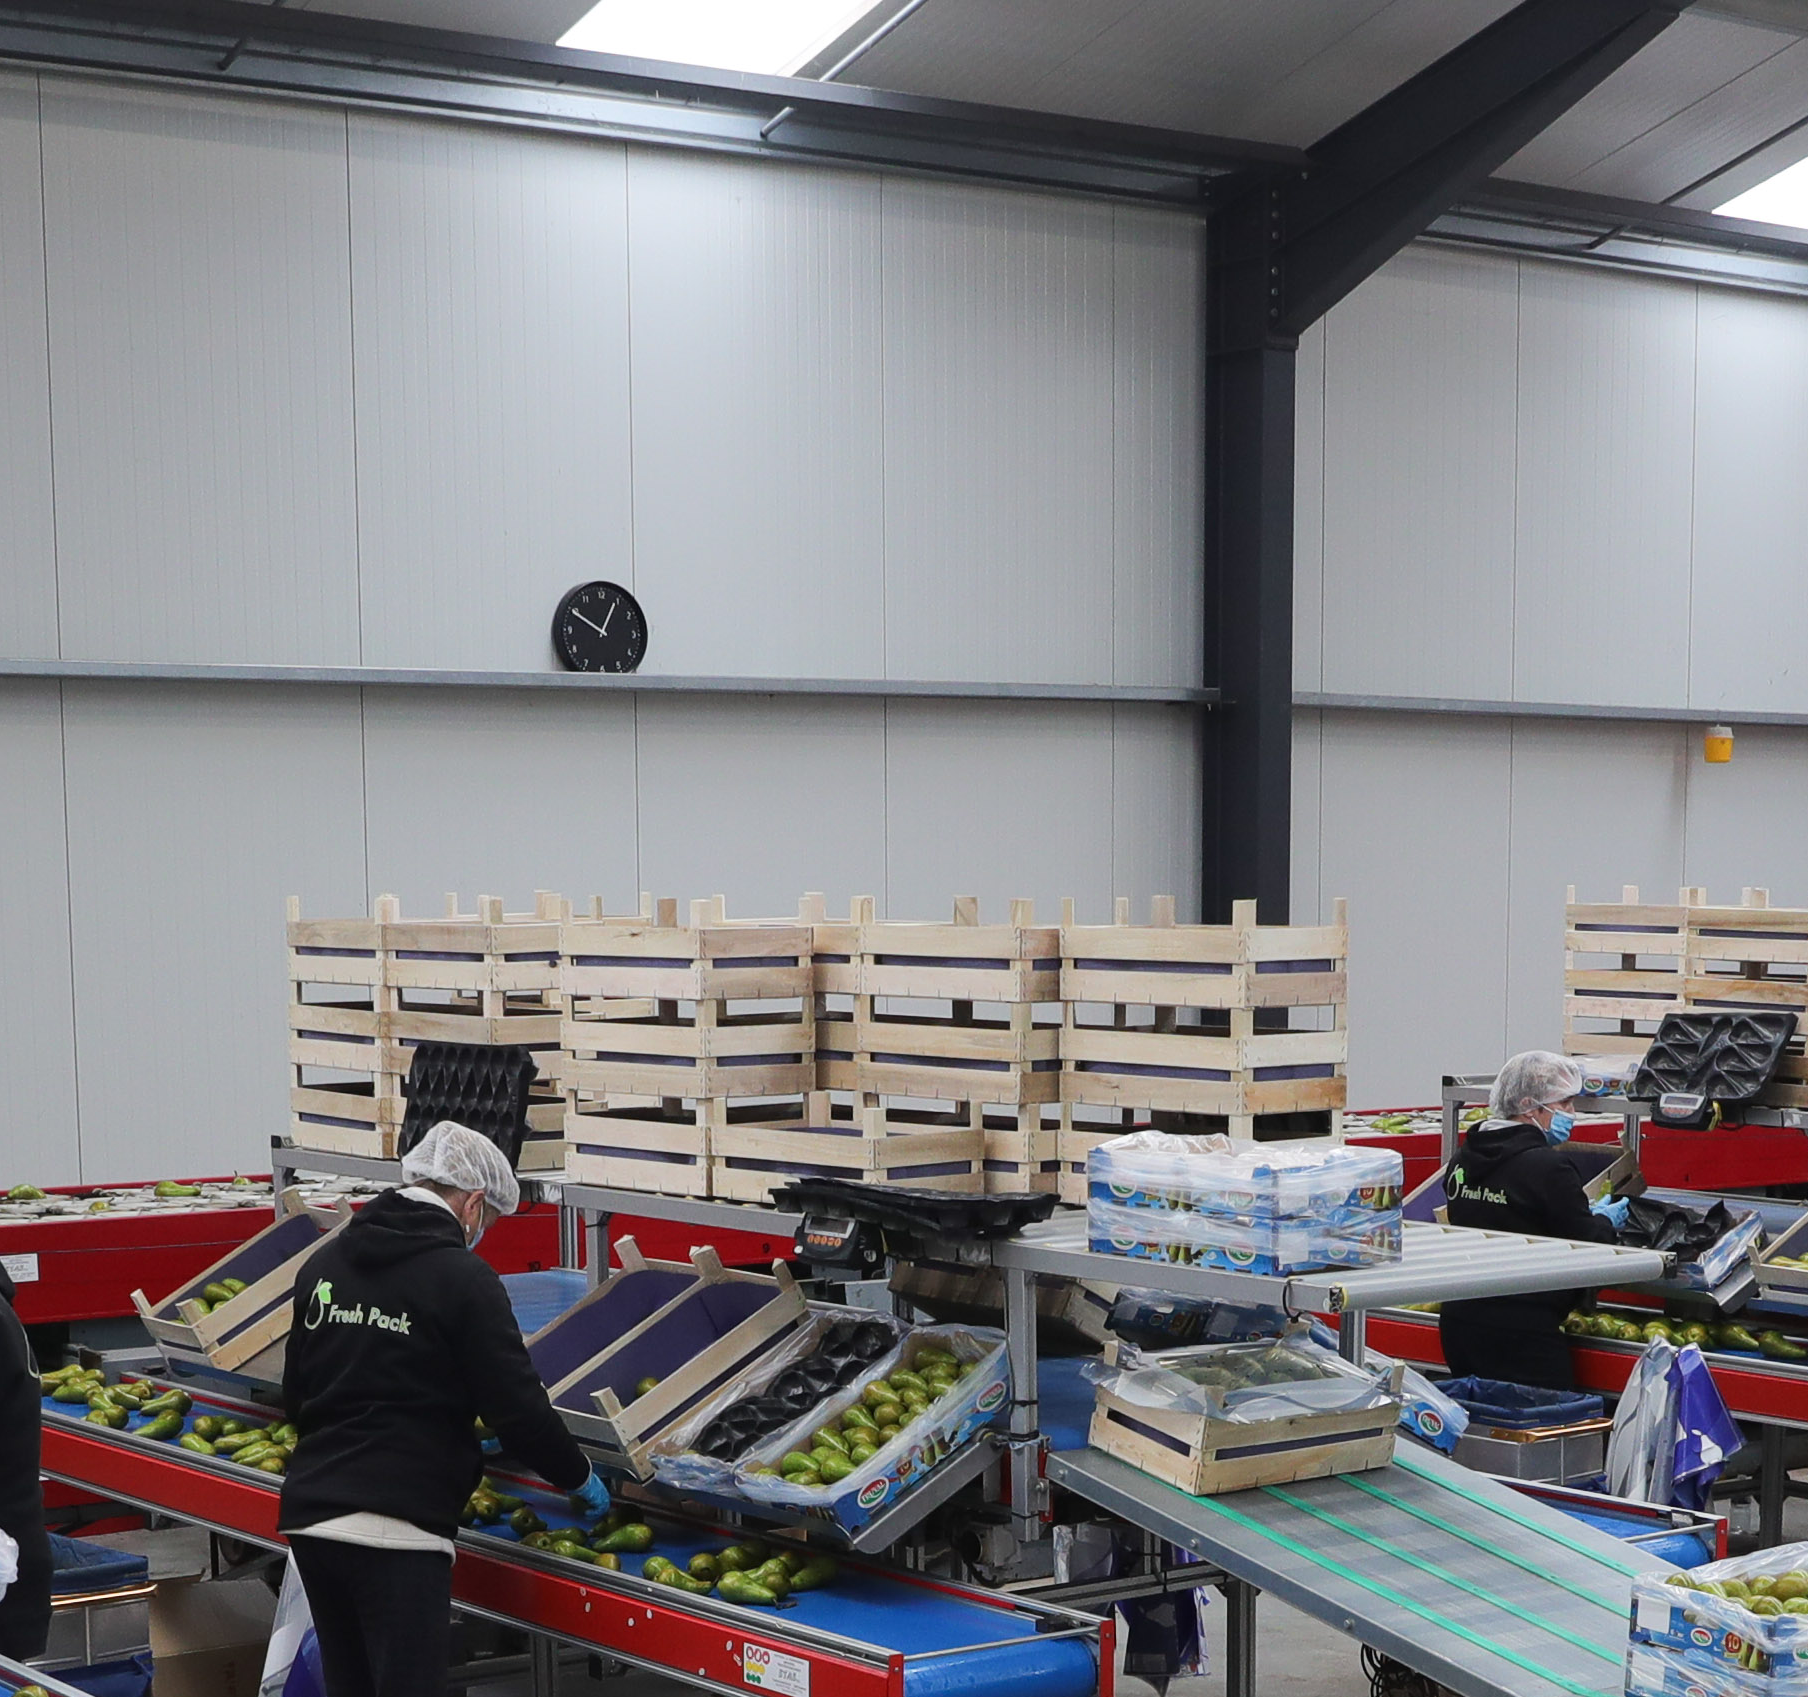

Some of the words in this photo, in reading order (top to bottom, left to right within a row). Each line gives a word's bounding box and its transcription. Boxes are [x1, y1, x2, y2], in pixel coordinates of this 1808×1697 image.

[1482, 1187, 1508, 1205] Pack
[328, 1303, 364, 1324] Fresh
[367, 1306, 412, 1335] Pack
[1727, 1634, 1741, 1650] 10
